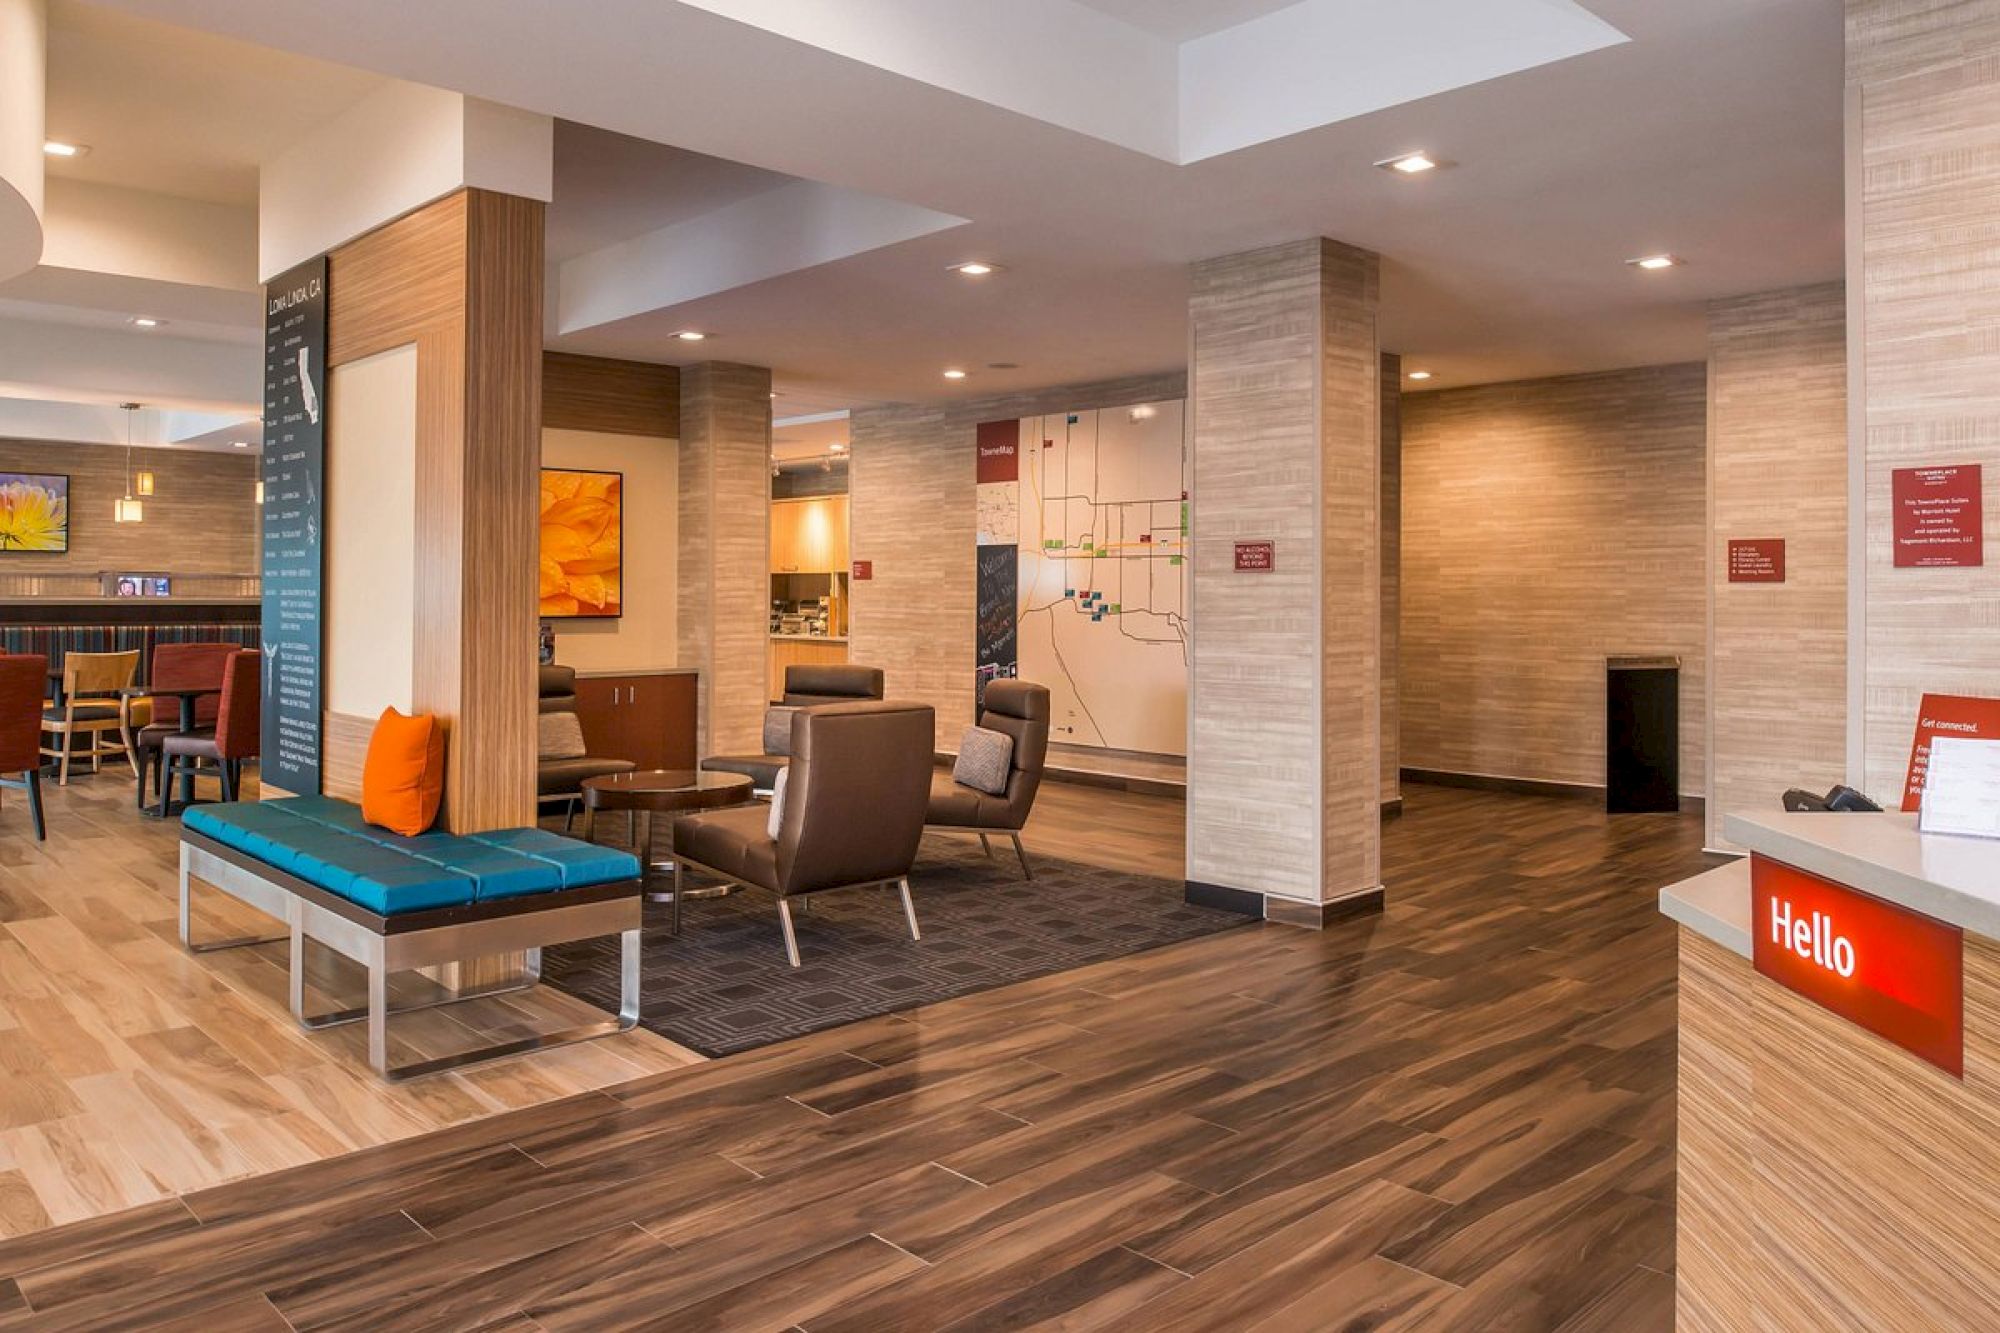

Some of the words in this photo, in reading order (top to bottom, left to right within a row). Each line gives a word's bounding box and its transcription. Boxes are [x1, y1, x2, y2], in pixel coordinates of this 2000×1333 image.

[310, 277, 321, 297] CA
[980, 445, 1014, 456] TowneMap
[1926, 528, 1951, 536] operated
[1921, 717, 1936, 728] Get
[1936, 720, 1978, 733] connected.
[1771, 896, 1855, 978] Hello
